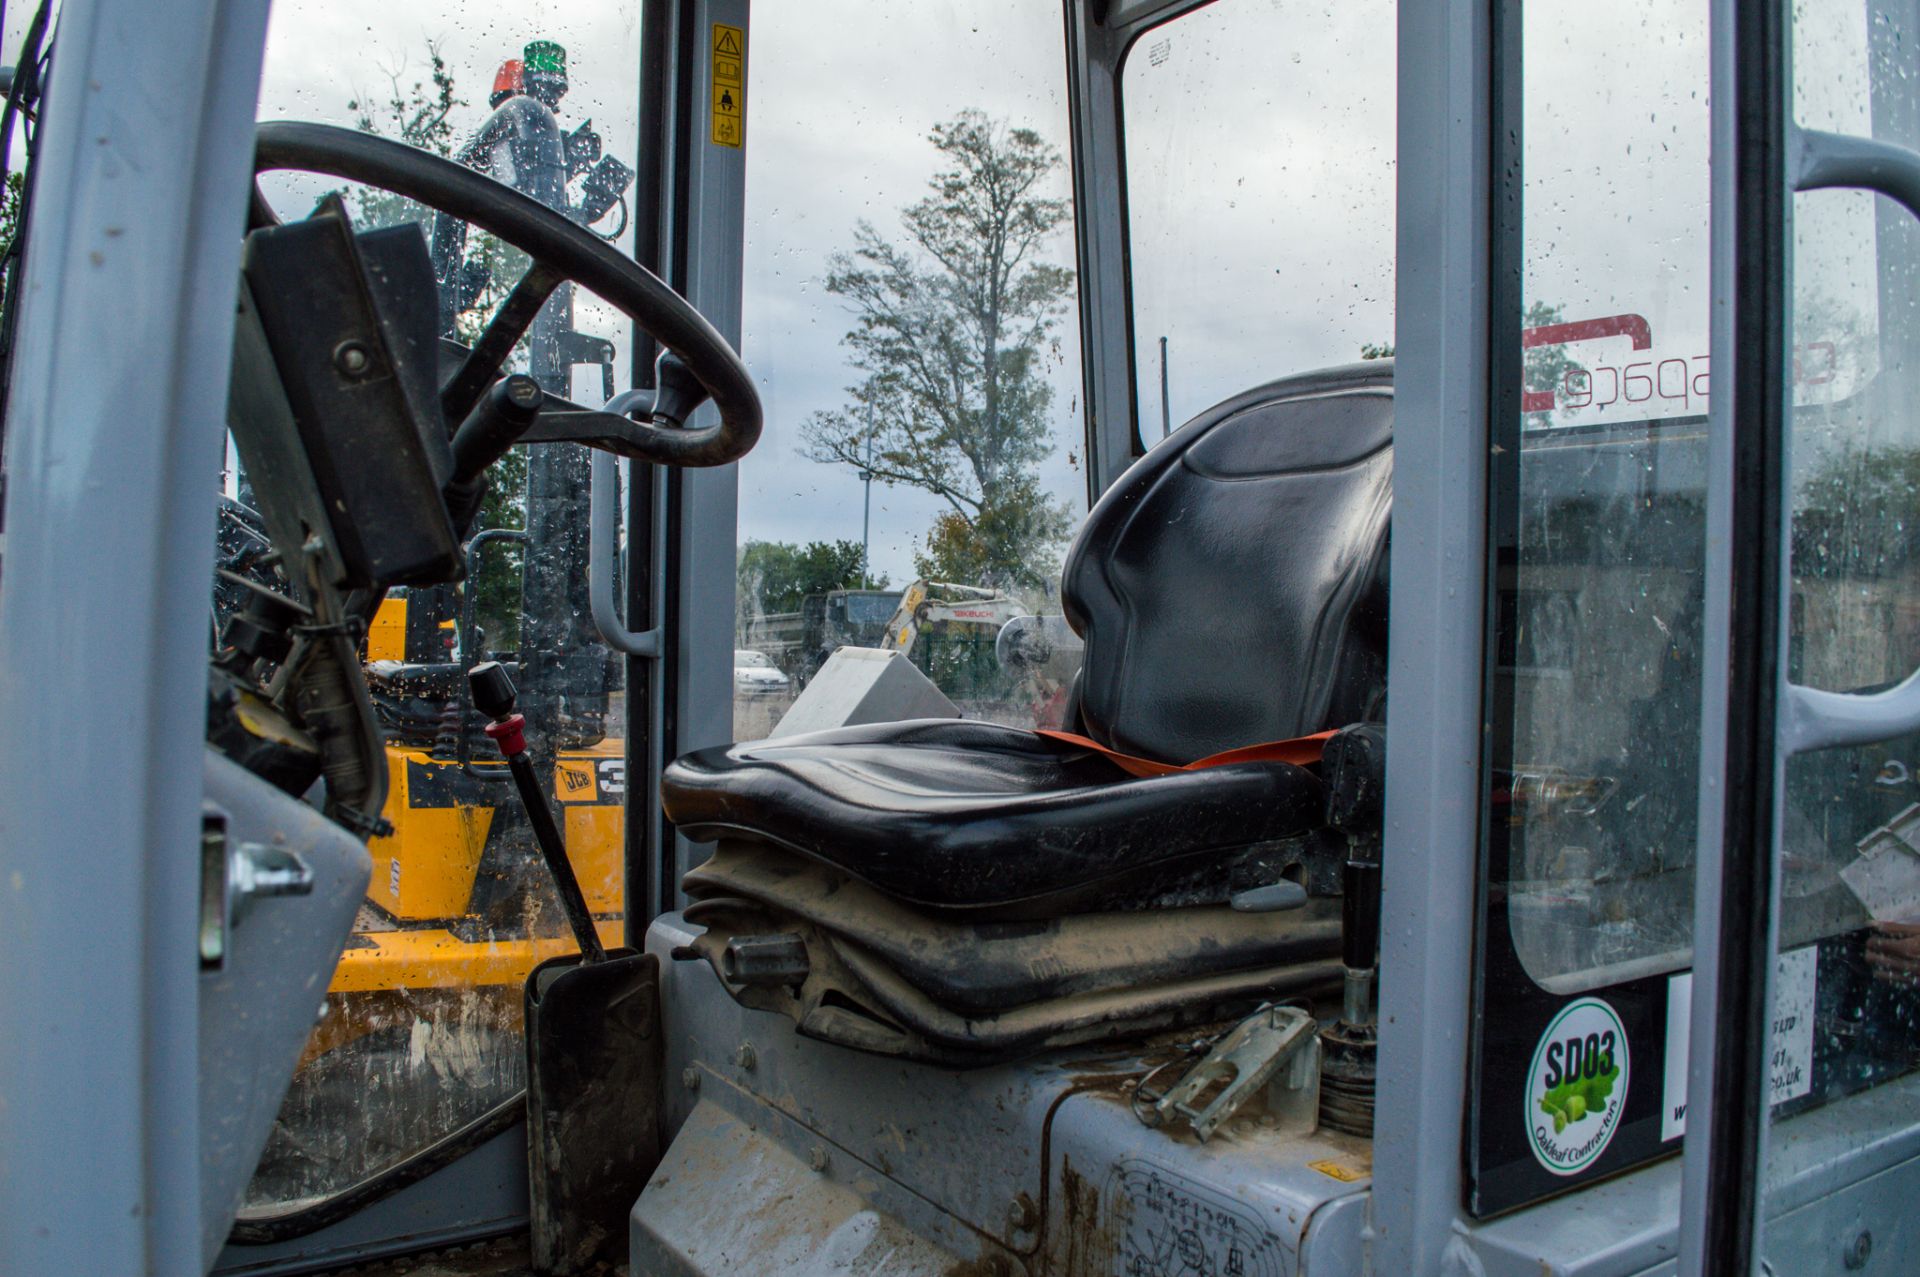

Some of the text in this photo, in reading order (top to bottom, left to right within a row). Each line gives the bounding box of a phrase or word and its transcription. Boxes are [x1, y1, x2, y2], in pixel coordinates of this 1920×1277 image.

[566, 770, 590, 789] JCB
[1545, 1030, 1615, 1090] SD03
[1536, 1100, 1617, 1163] Oakleaf Contractors
